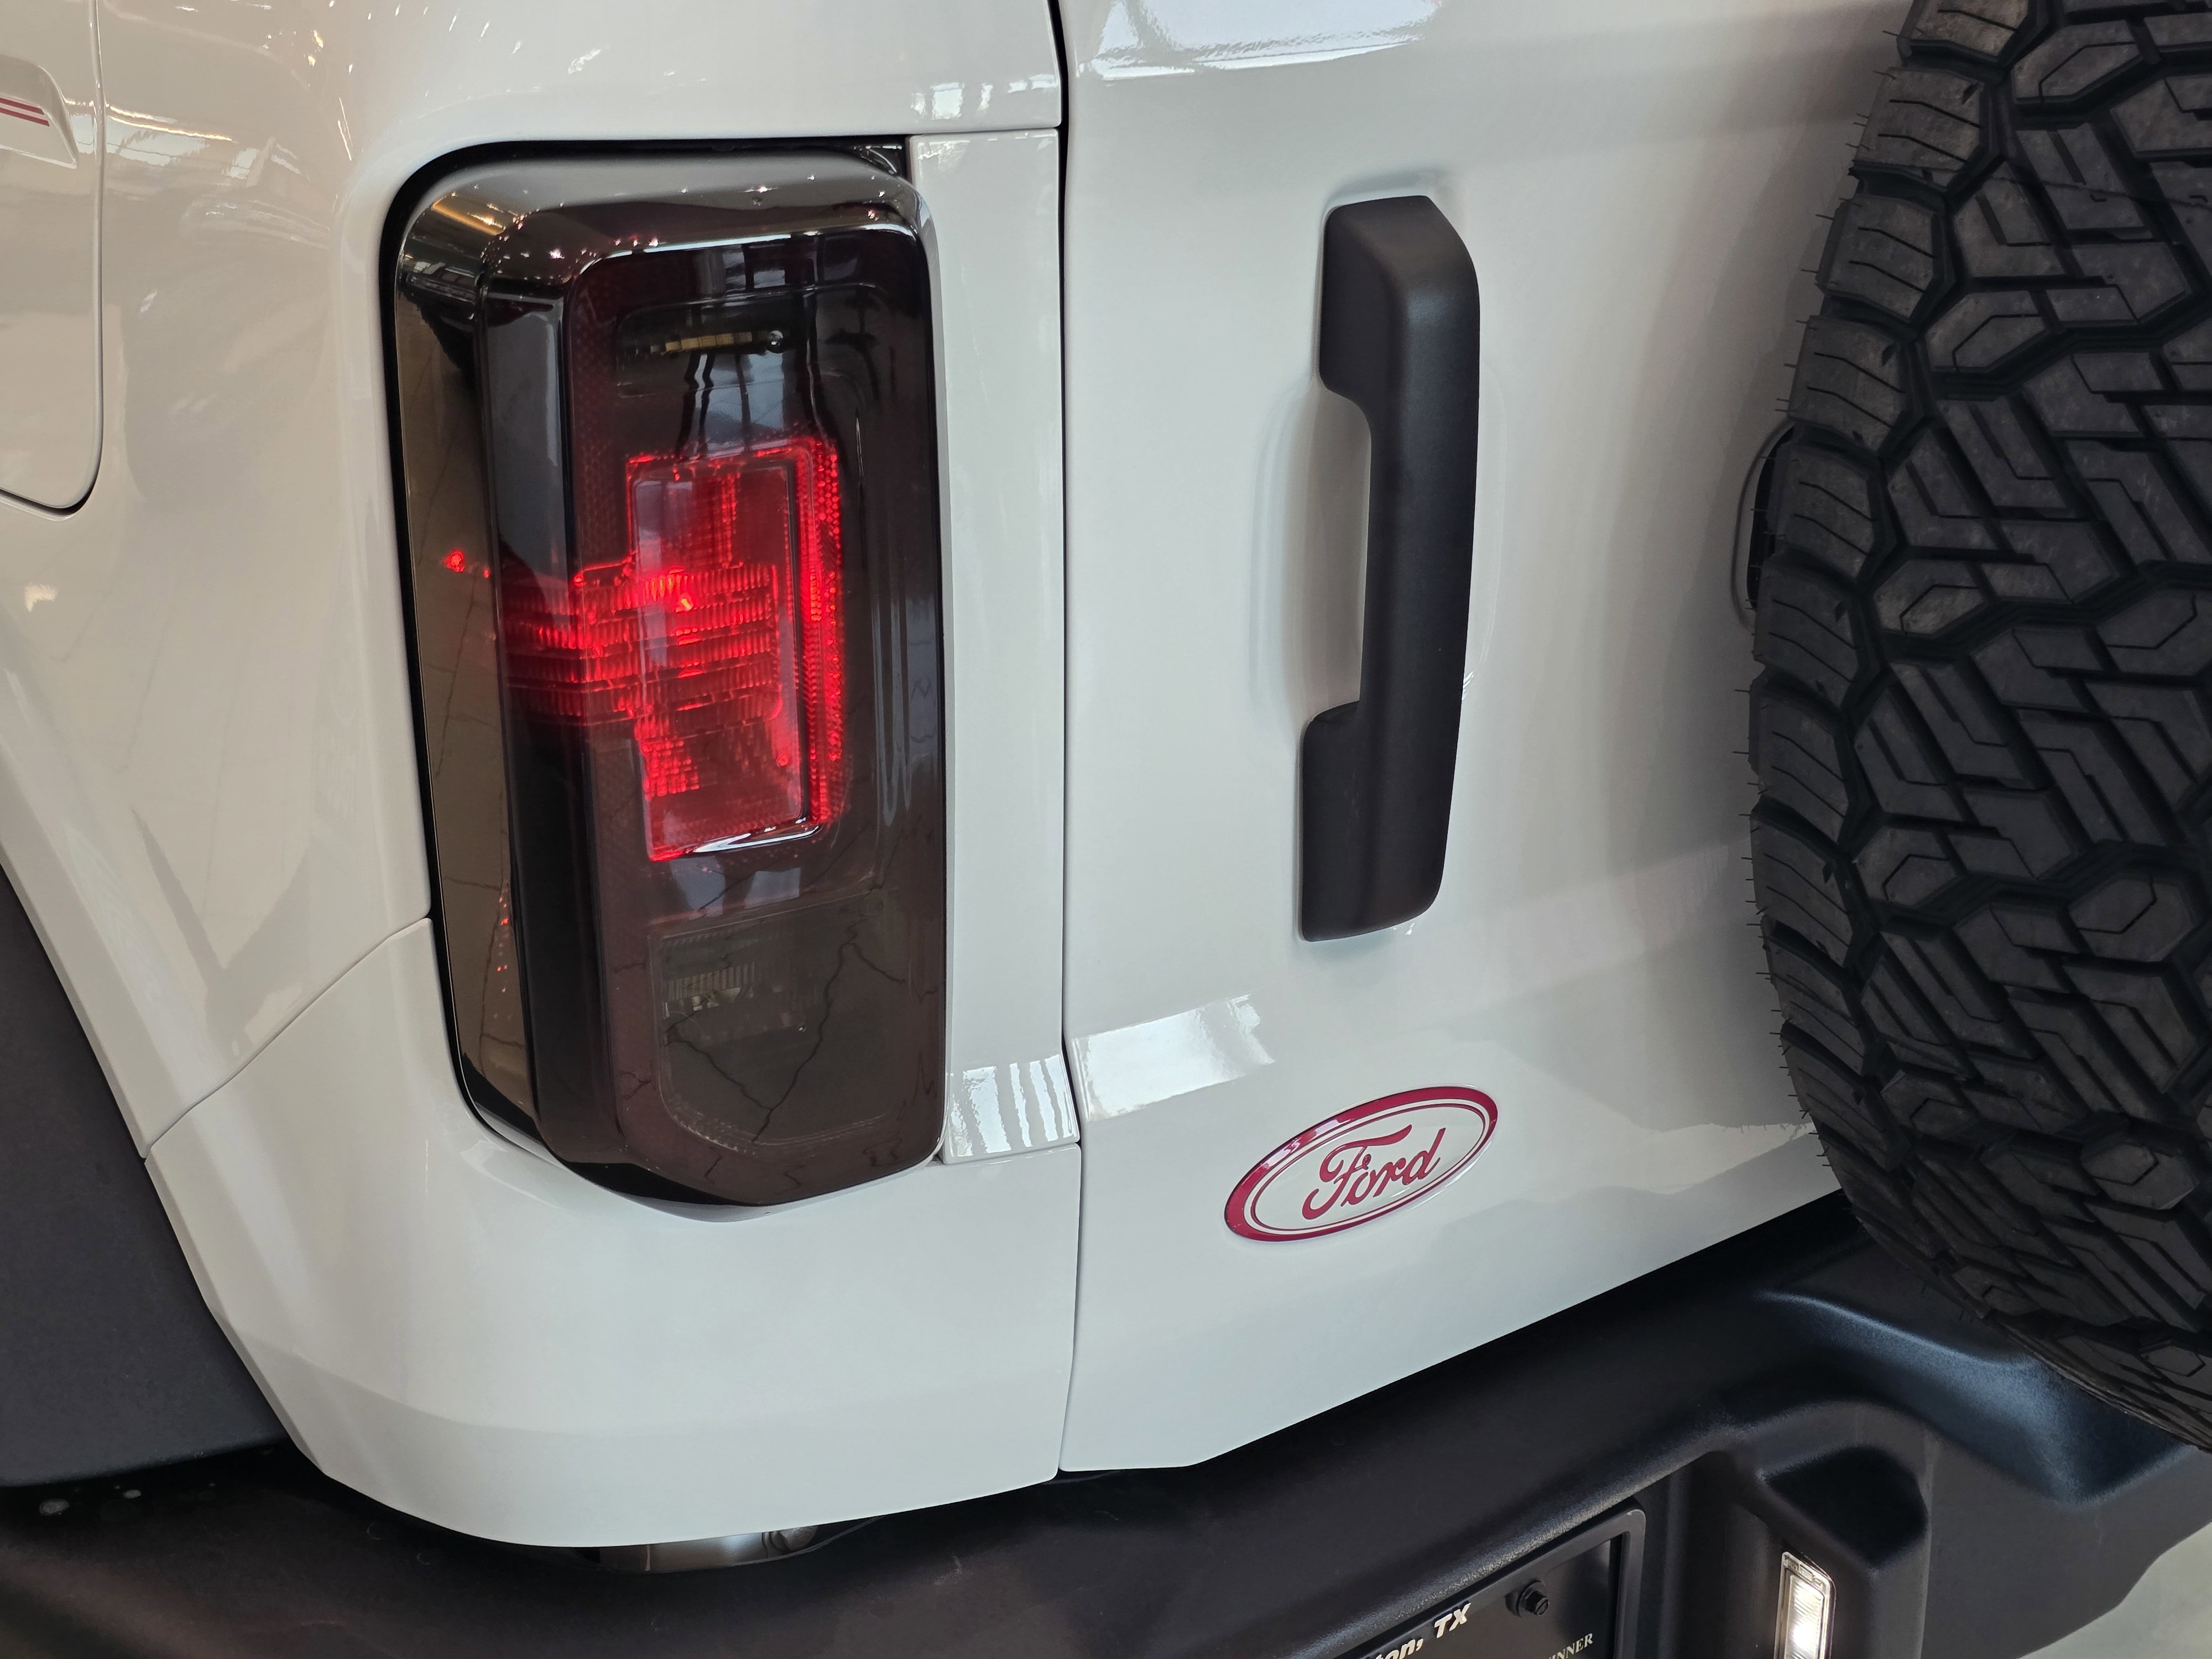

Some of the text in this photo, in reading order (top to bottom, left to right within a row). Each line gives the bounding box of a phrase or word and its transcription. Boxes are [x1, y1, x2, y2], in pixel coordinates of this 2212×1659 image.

[1302, 1124, 1446, 1220] Ford
[1375, 1603, 1471, 1659] on, TX
[1549, 1633, 1593, 1659] NNER
